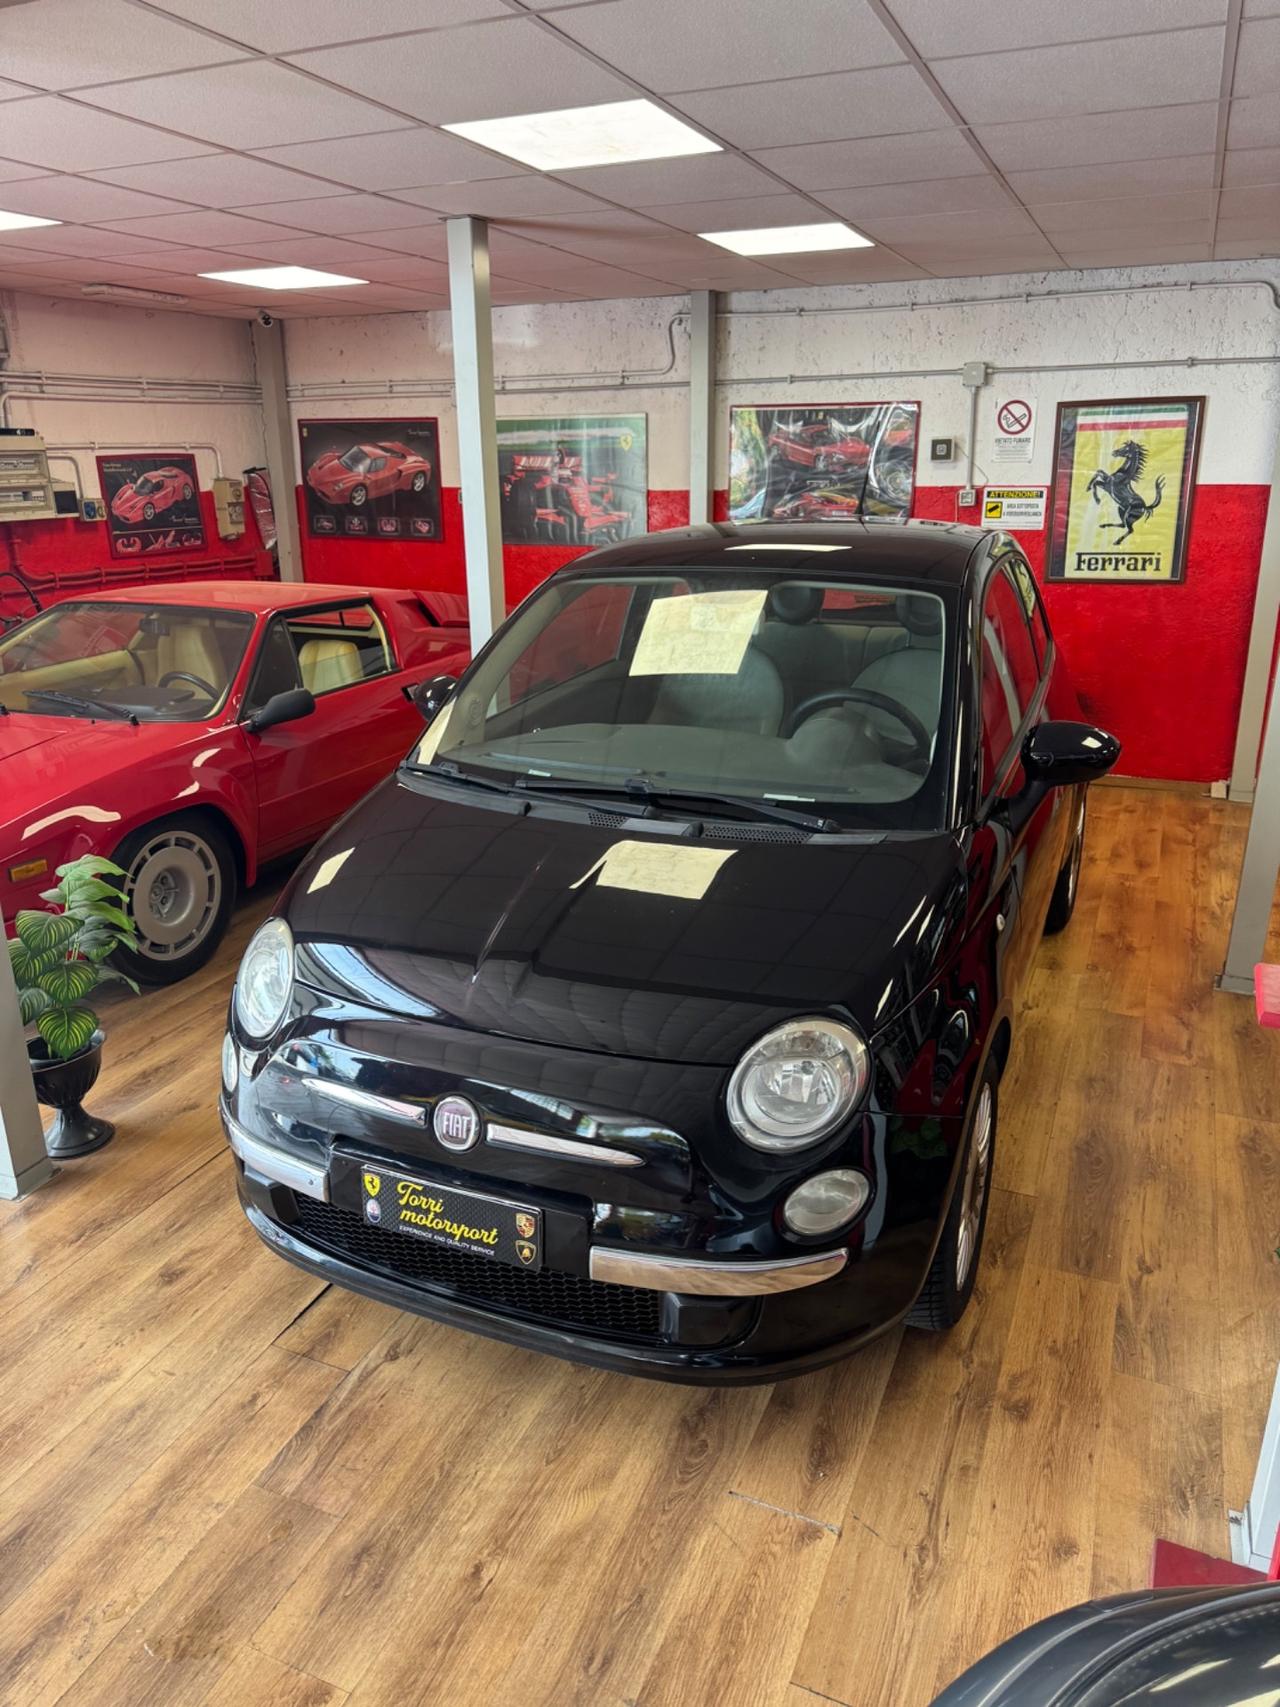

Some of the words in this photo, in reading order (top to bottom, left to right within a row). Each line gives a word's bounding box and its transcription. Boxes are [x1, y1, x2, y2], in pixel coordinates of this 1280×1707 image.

[990, 491, 1040, 499] ATTENZIONE!
[1074, 552, 1162, 571] Ferrari
[442, 1112, 471, 1139] FIAT
[397, 1181, 445, 1213] Torri
[400, 1209, 499, 1245] motorsport
[434, 1235, 446, 1243] AND
[446, 1238, 470, 1249] QUALITY
